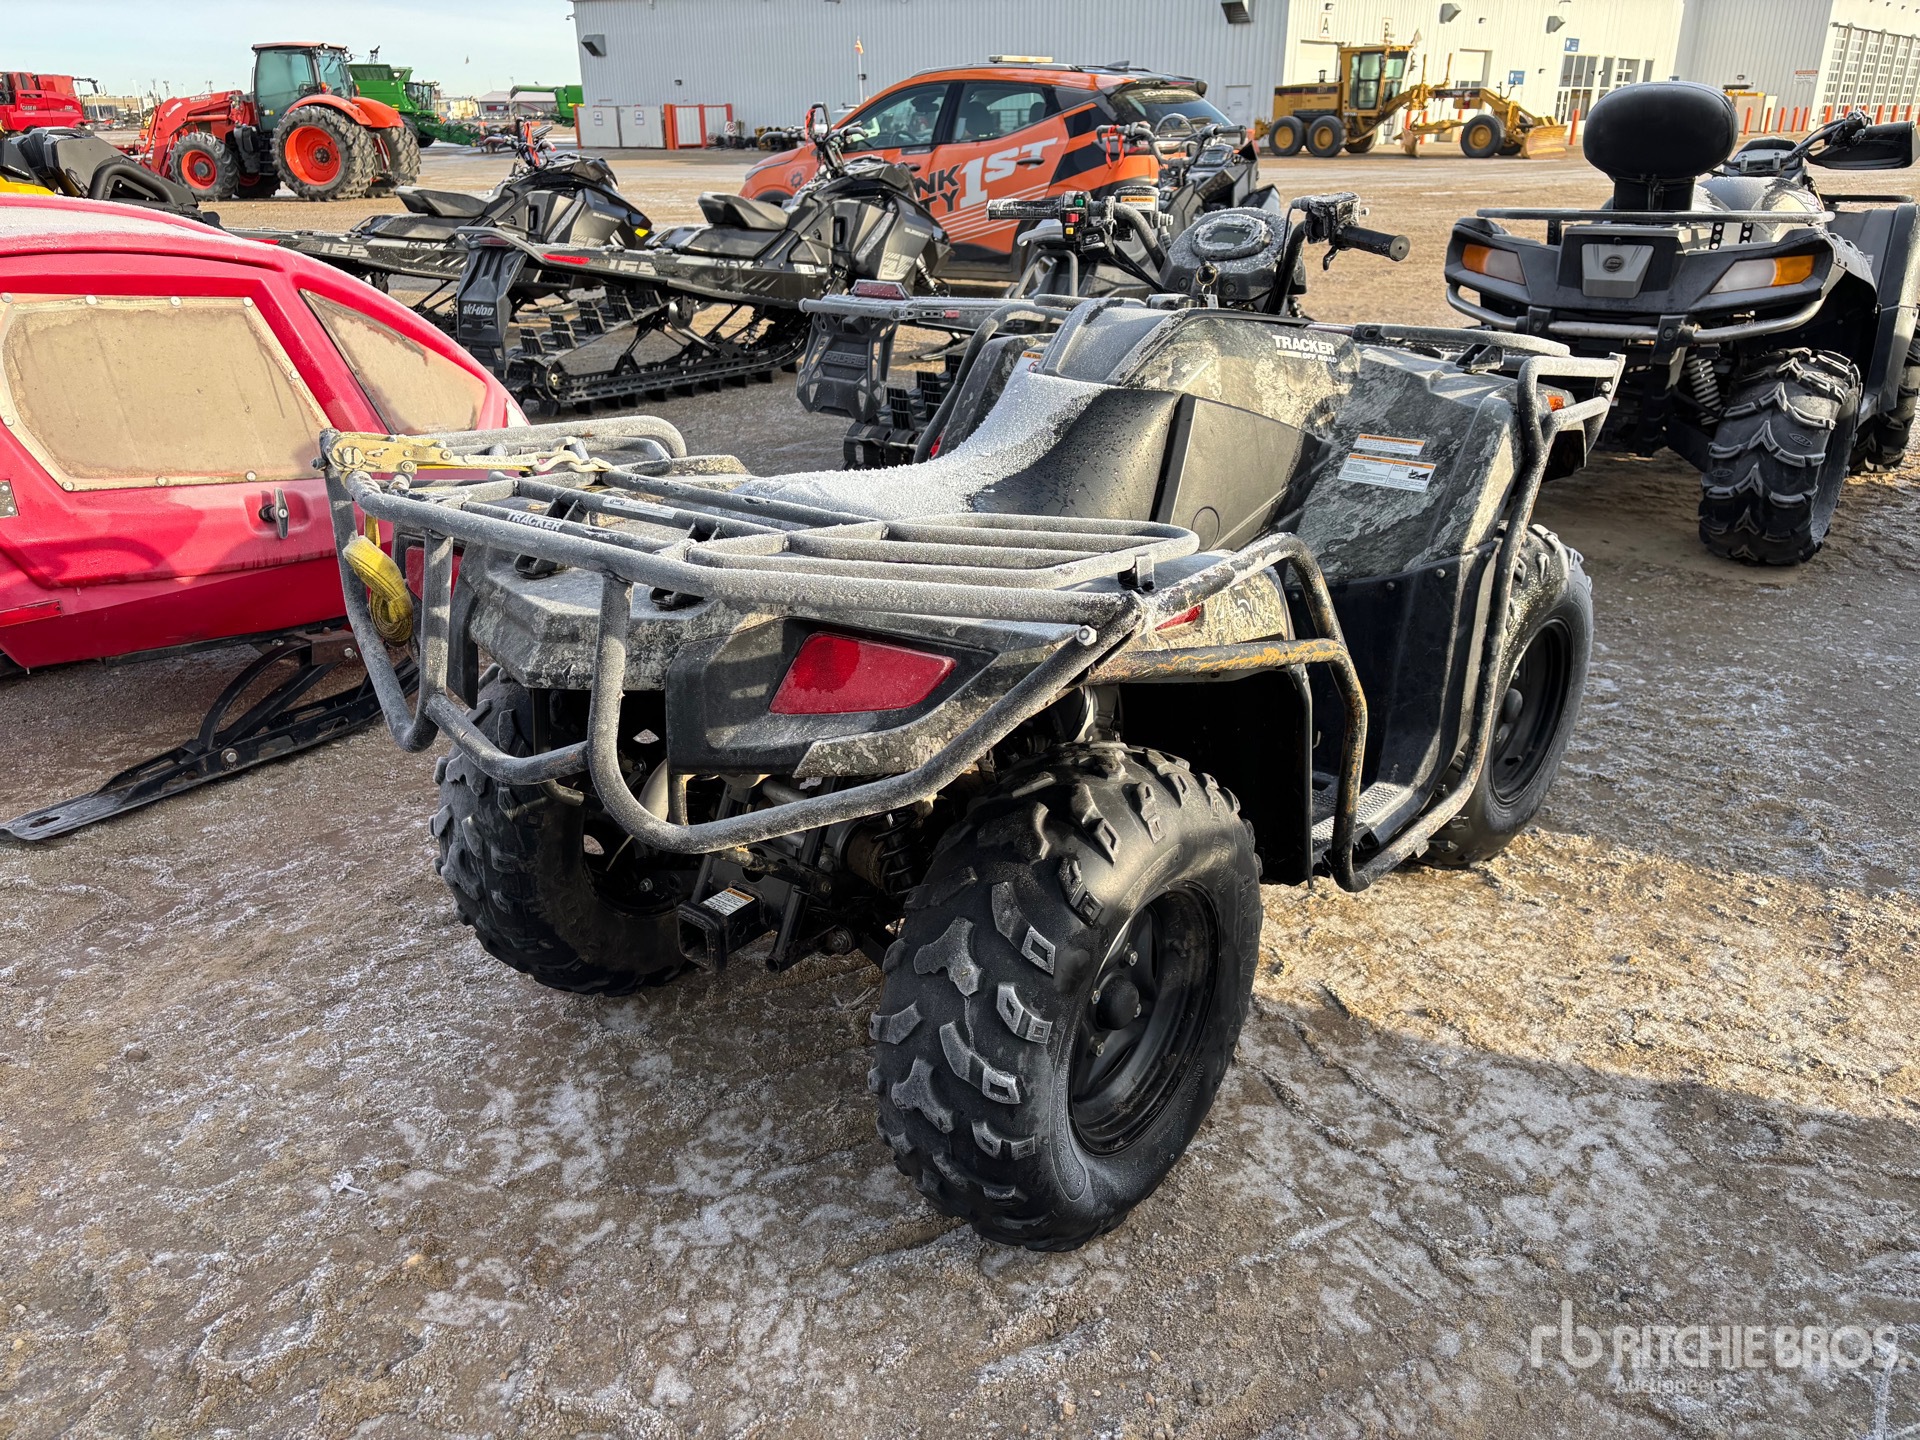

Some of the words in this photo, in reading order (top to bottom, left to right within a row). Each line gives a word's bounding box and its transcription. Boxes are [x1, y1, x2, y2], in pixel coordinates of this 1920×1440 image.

[1321, 17, 1329, 34] A
[960, 137, 1058, 209] 1ST
[320, 242, 369, 258] 165
[608, 259, 656, 276] 165
[1272, 334, 1336, 356] TRACKER
[824, 353, 867, 366] POLARIS
[1302, 352, 1317, 360] OFF
[1317, 354, 1338, 363] ROAD
[506, 511, 564, 531] TRACKER
